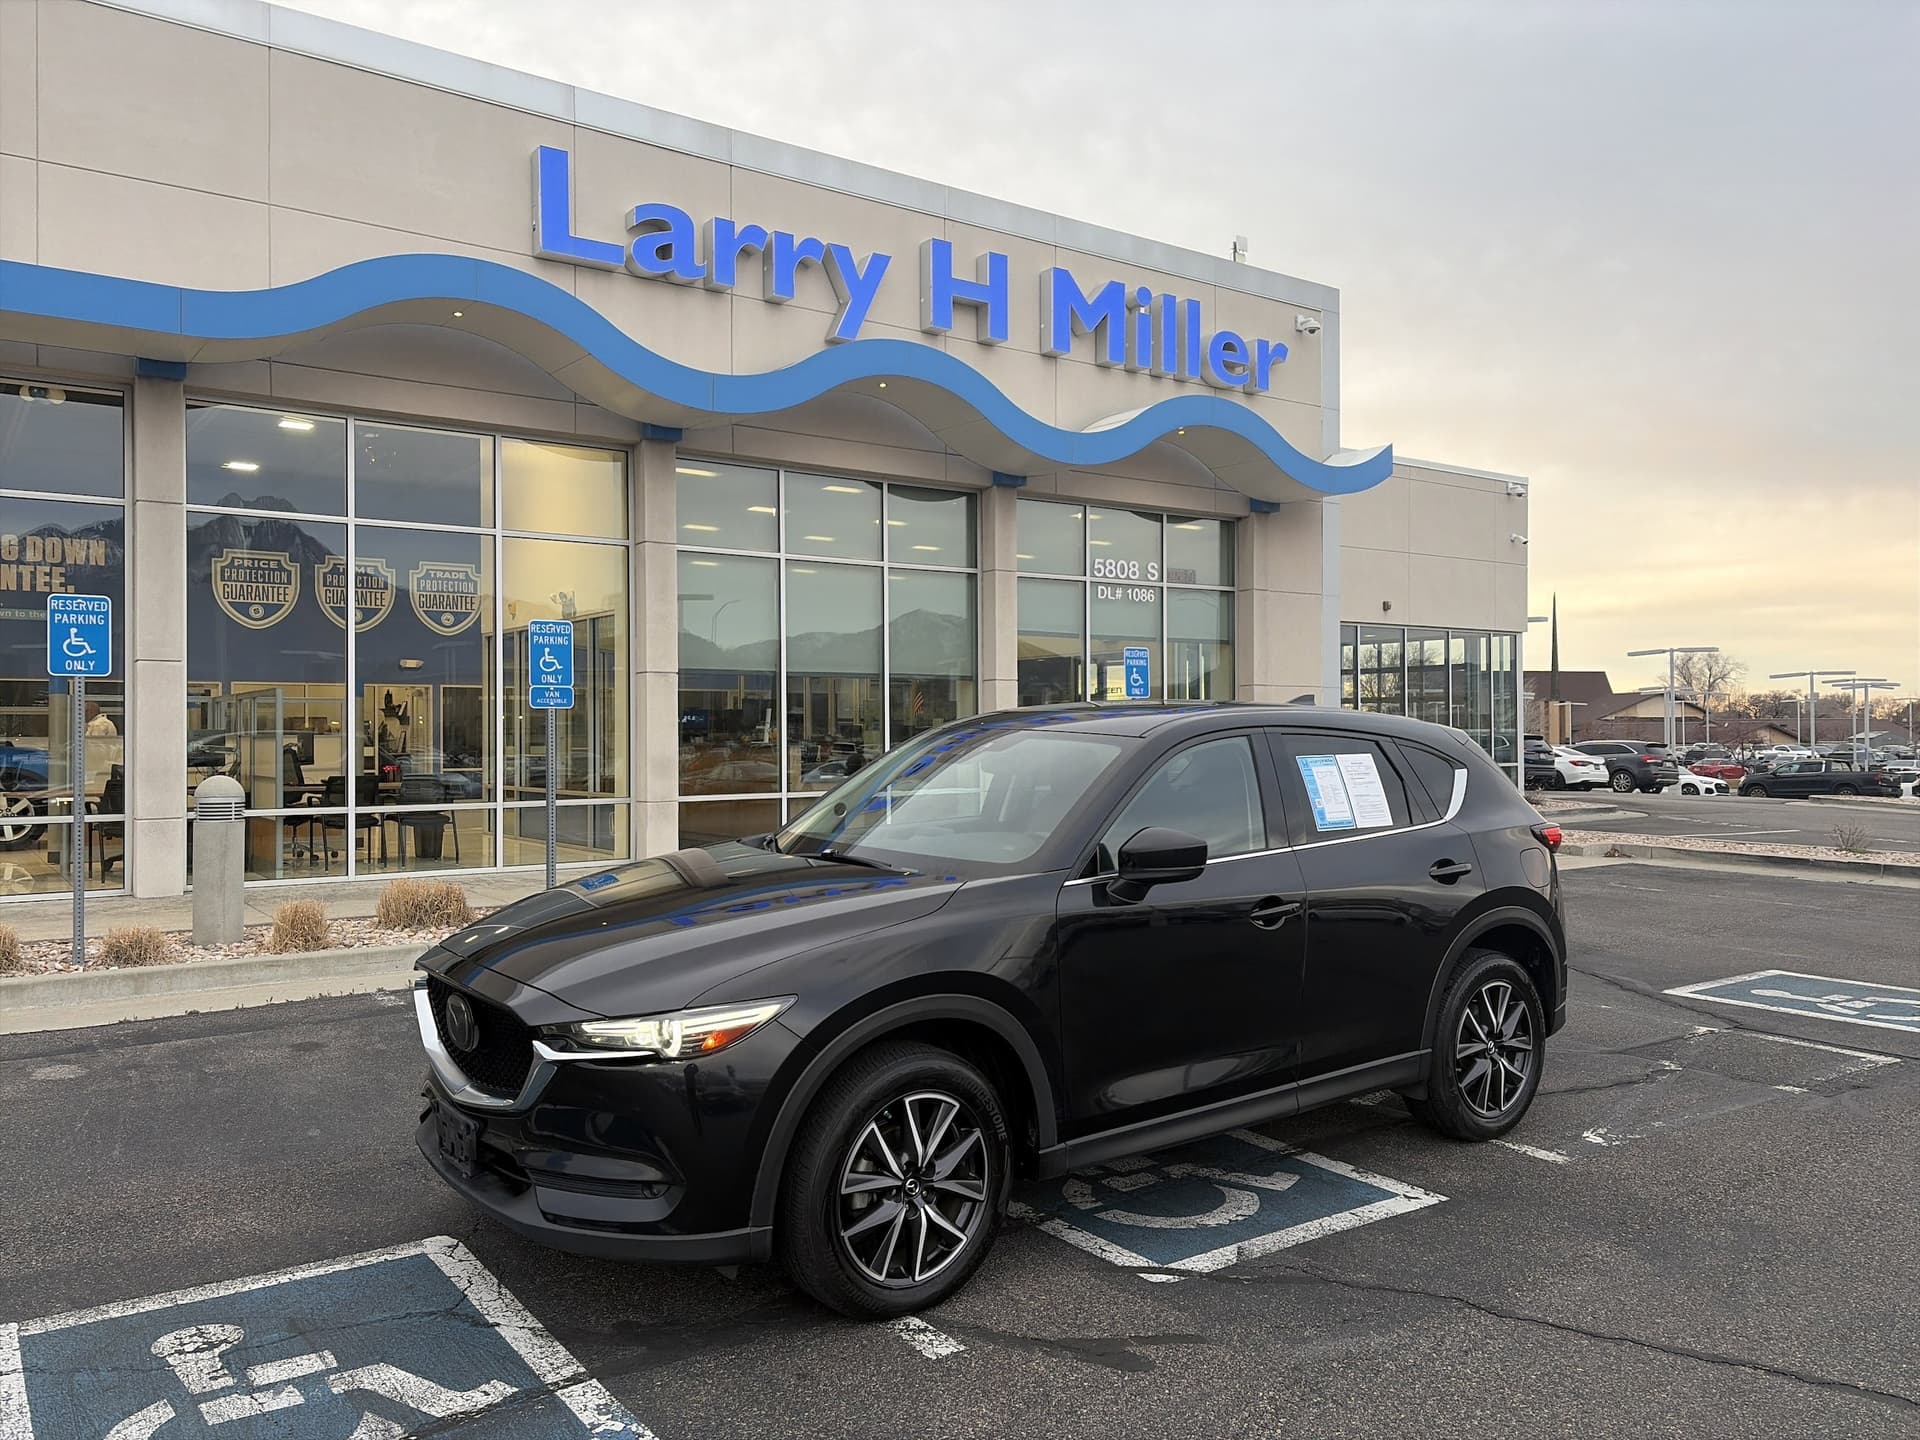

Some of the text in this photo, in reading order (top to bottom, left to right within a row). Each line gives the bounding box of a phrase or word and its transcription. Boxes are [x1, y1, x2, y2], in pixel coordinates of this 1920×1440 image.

[536, 145, 1289, 391] Larry H Miller
[26, 535, 106, 566] DOWN
[233, 558, 279, 569] PRICE
[336, 564, 376, 575] TME
[1093, 558, 1140, 580] 5808
[1147, 562, 1159, 580] S
[0, 564, 75, 593] NTEE.
[224, 567, 288, 584] PROTECTION
[326, 574, 385, 589] PROCTION
[428, 570, 467, 580] TRADE
[222, 583, 290, 603] GUARANTEE
[420, 579, 474, 593] PROTECTION
[324, 588, 386, 608] GUAANTEE
[1097, 585, 1155, 602] DL# 1086
[50, 599, 108, 612] RESERVED
[418, 593, 476, 611] GUARANTEE
[54, 613, 105, 625] PARKING
[530, 624, 571, 634] RESERVED
[533, 635, 569, 646] PARKING
[65, 659, 95, 671] ONLY
[541, 674, 563, 683] ONLY
[544, 690, 561, 698] VAN
